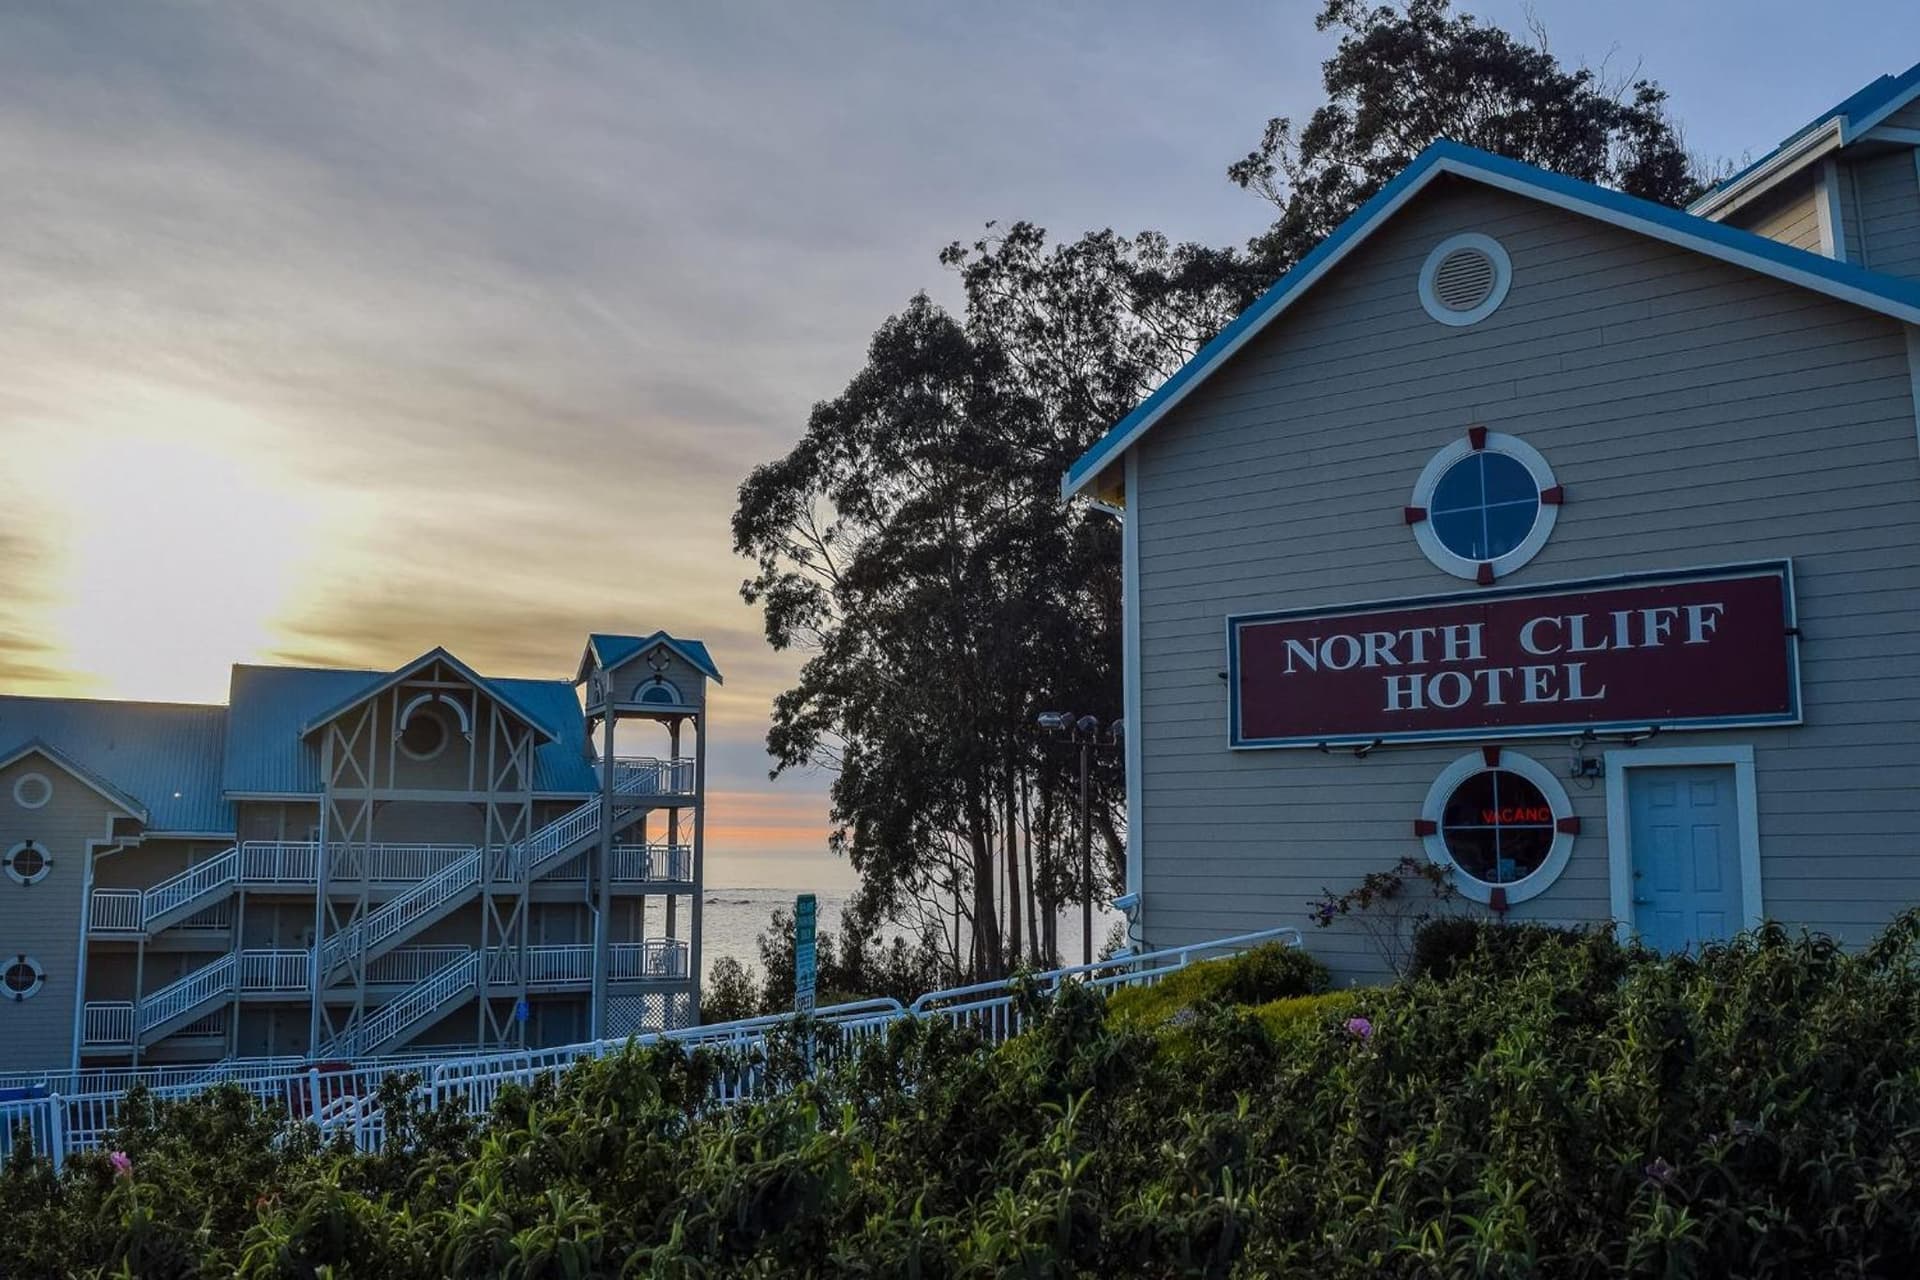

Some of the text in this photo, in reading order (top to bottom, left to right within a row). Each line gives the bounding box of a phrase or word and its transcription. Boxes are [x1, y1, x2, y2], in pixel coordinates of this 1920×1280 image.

[1283, 603, 1725, 674] NORTH CLIFF
[1382, 662, 1606, 712] HOTEL
